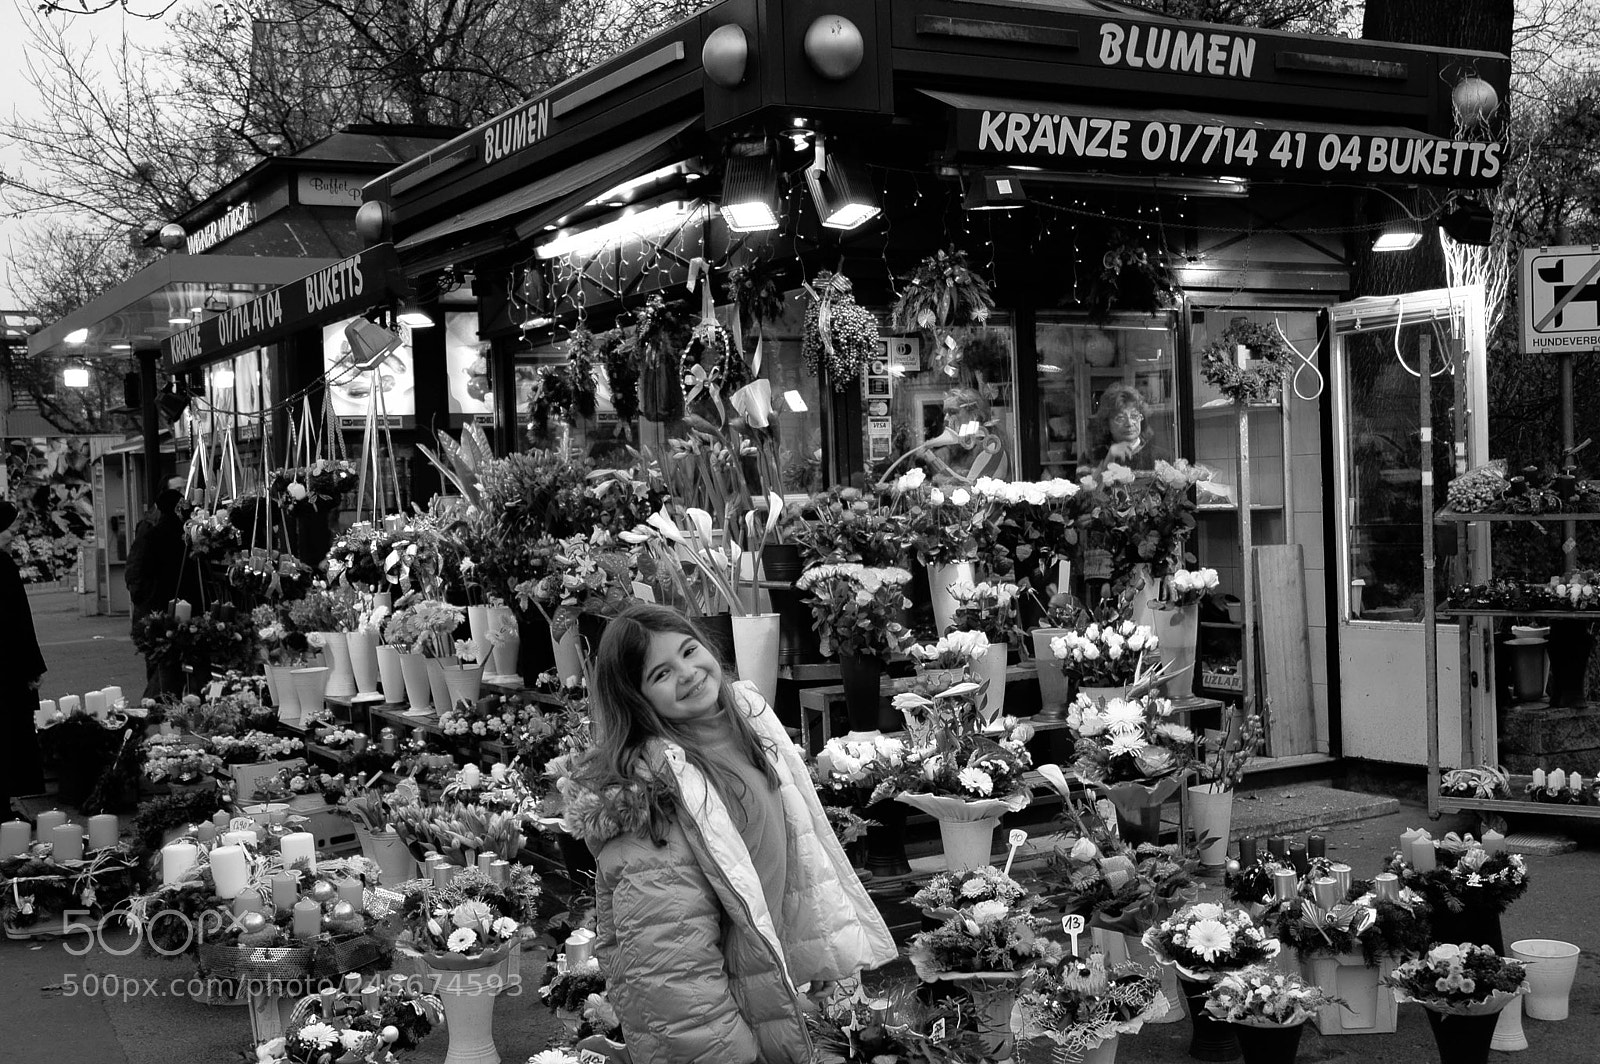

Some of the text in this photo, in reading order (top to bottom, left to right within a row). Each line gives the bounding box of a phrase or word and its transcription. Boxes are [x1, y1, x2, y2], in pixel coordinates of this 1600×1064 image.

[1099, 22, 1256, 78] BLUMEN
[484, 98, 549, 164] BLUMEN
[978, 110, 1501, 178] KRÄNZE 01/714 41 04 BUKETTS
[309, 177, 348, 195] Buffet
[218, 303, 250, 346] 01/714
[252, 297, 265, 332] 41
[266, 289, 283, 328] 04
[305, 254, 363, 314] BUKETTS
[1532, 335, 1600, 347] HUNDEVERB
[1064, 915, 1081, 930] 13
